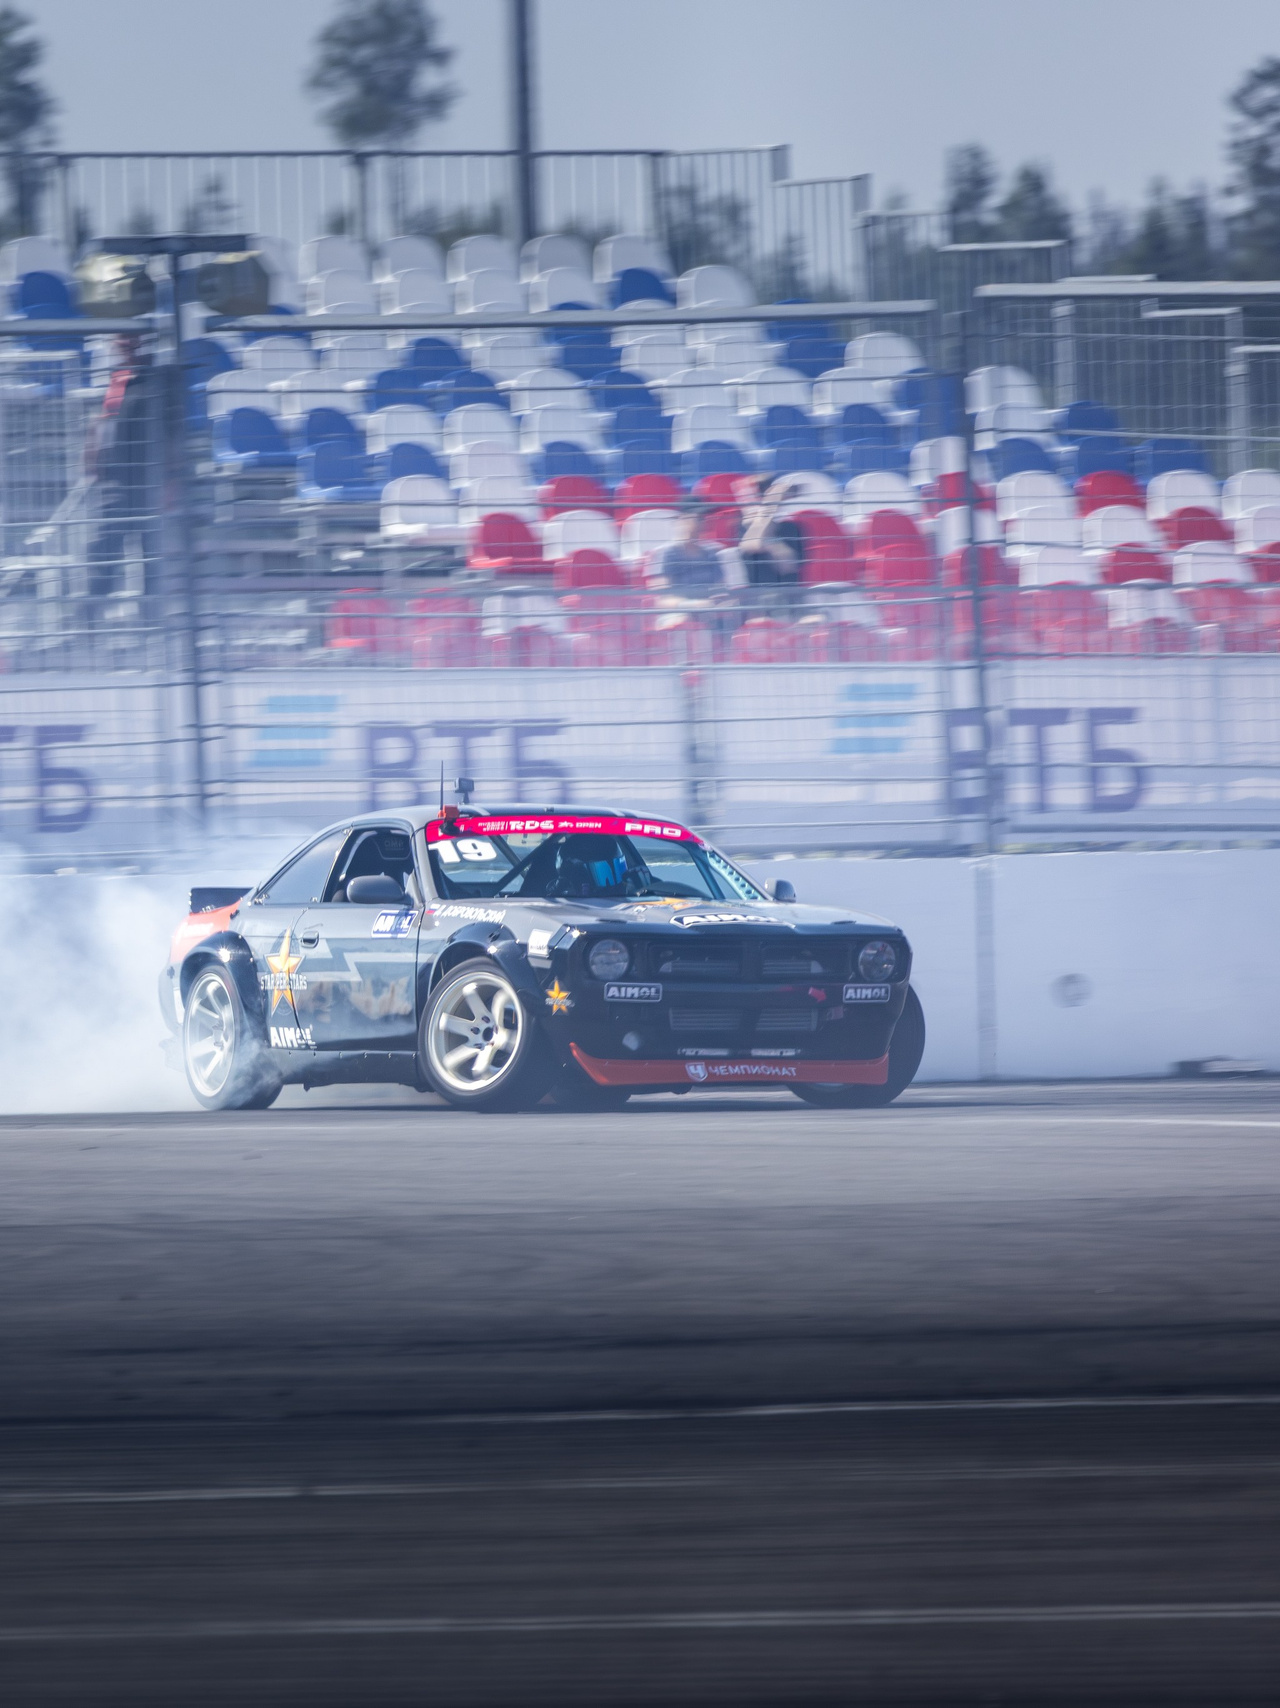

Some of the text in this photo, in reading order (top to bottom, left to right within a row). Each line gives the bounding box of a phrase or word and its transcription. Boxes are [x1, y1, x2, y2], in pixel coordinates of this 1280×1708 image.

[944, 707, 1148, 814] ВТБ
[509, 820, 555, 831] RDS
[625, 822, 682, 837] PRO
[427, 838, 497, 864] 19
[607, 986, 660, 998] AIMOL
[845, 988, 887, 999] AIMOL
[270, 1027, 316, 1048] AIMOL
[708, 1063, 797, 1077] ЧЕМПИОНАТ
